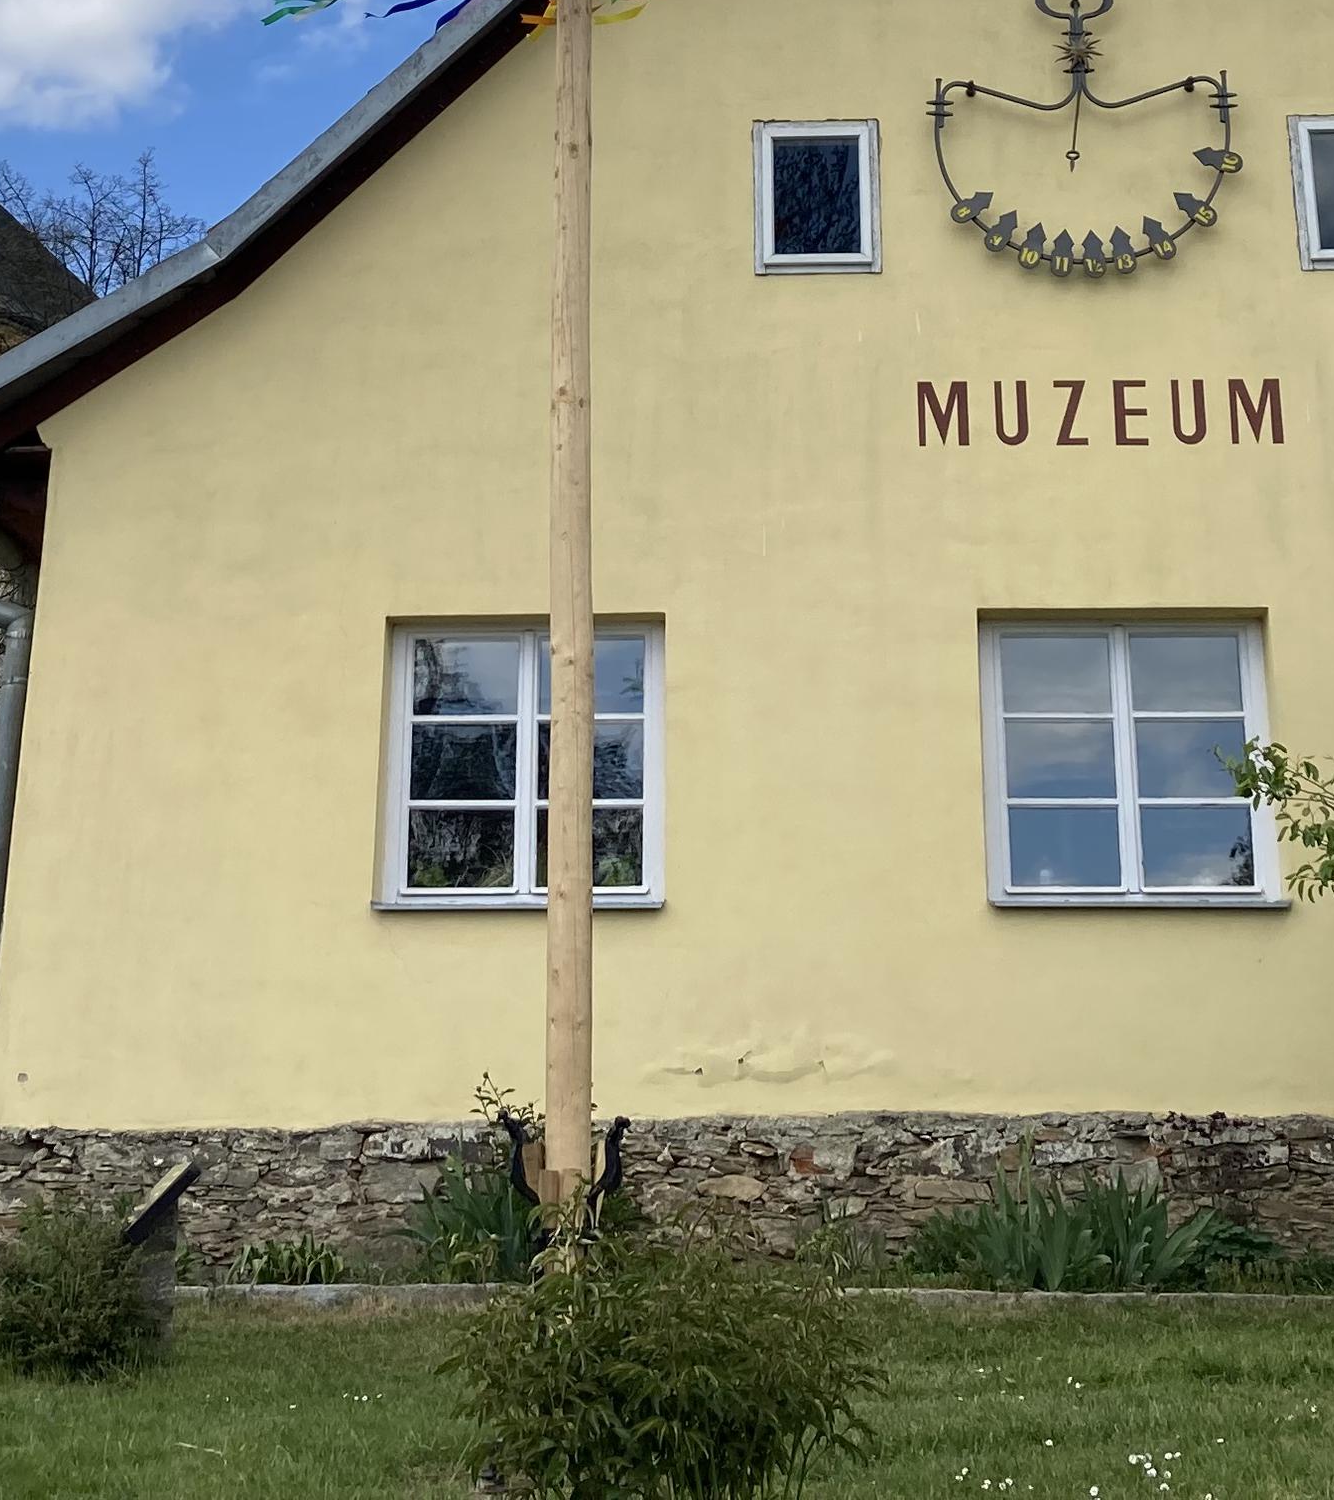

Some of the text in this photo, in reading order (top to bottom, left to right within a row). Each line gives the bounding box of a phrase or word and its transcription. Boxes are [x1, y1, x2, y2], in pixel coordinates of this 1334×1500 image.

[1020, 247, 1039, 265] 10
[1055, 255, 1069, 273] 11
[1085, 258, 1104, 273] 12
[1116, 253, 1135, 270] 13
[1154, 240, 1173, 256] 14
[1194, 205, 1214, 224] 15
[917, 377, 1285, 447] MUZEUM
